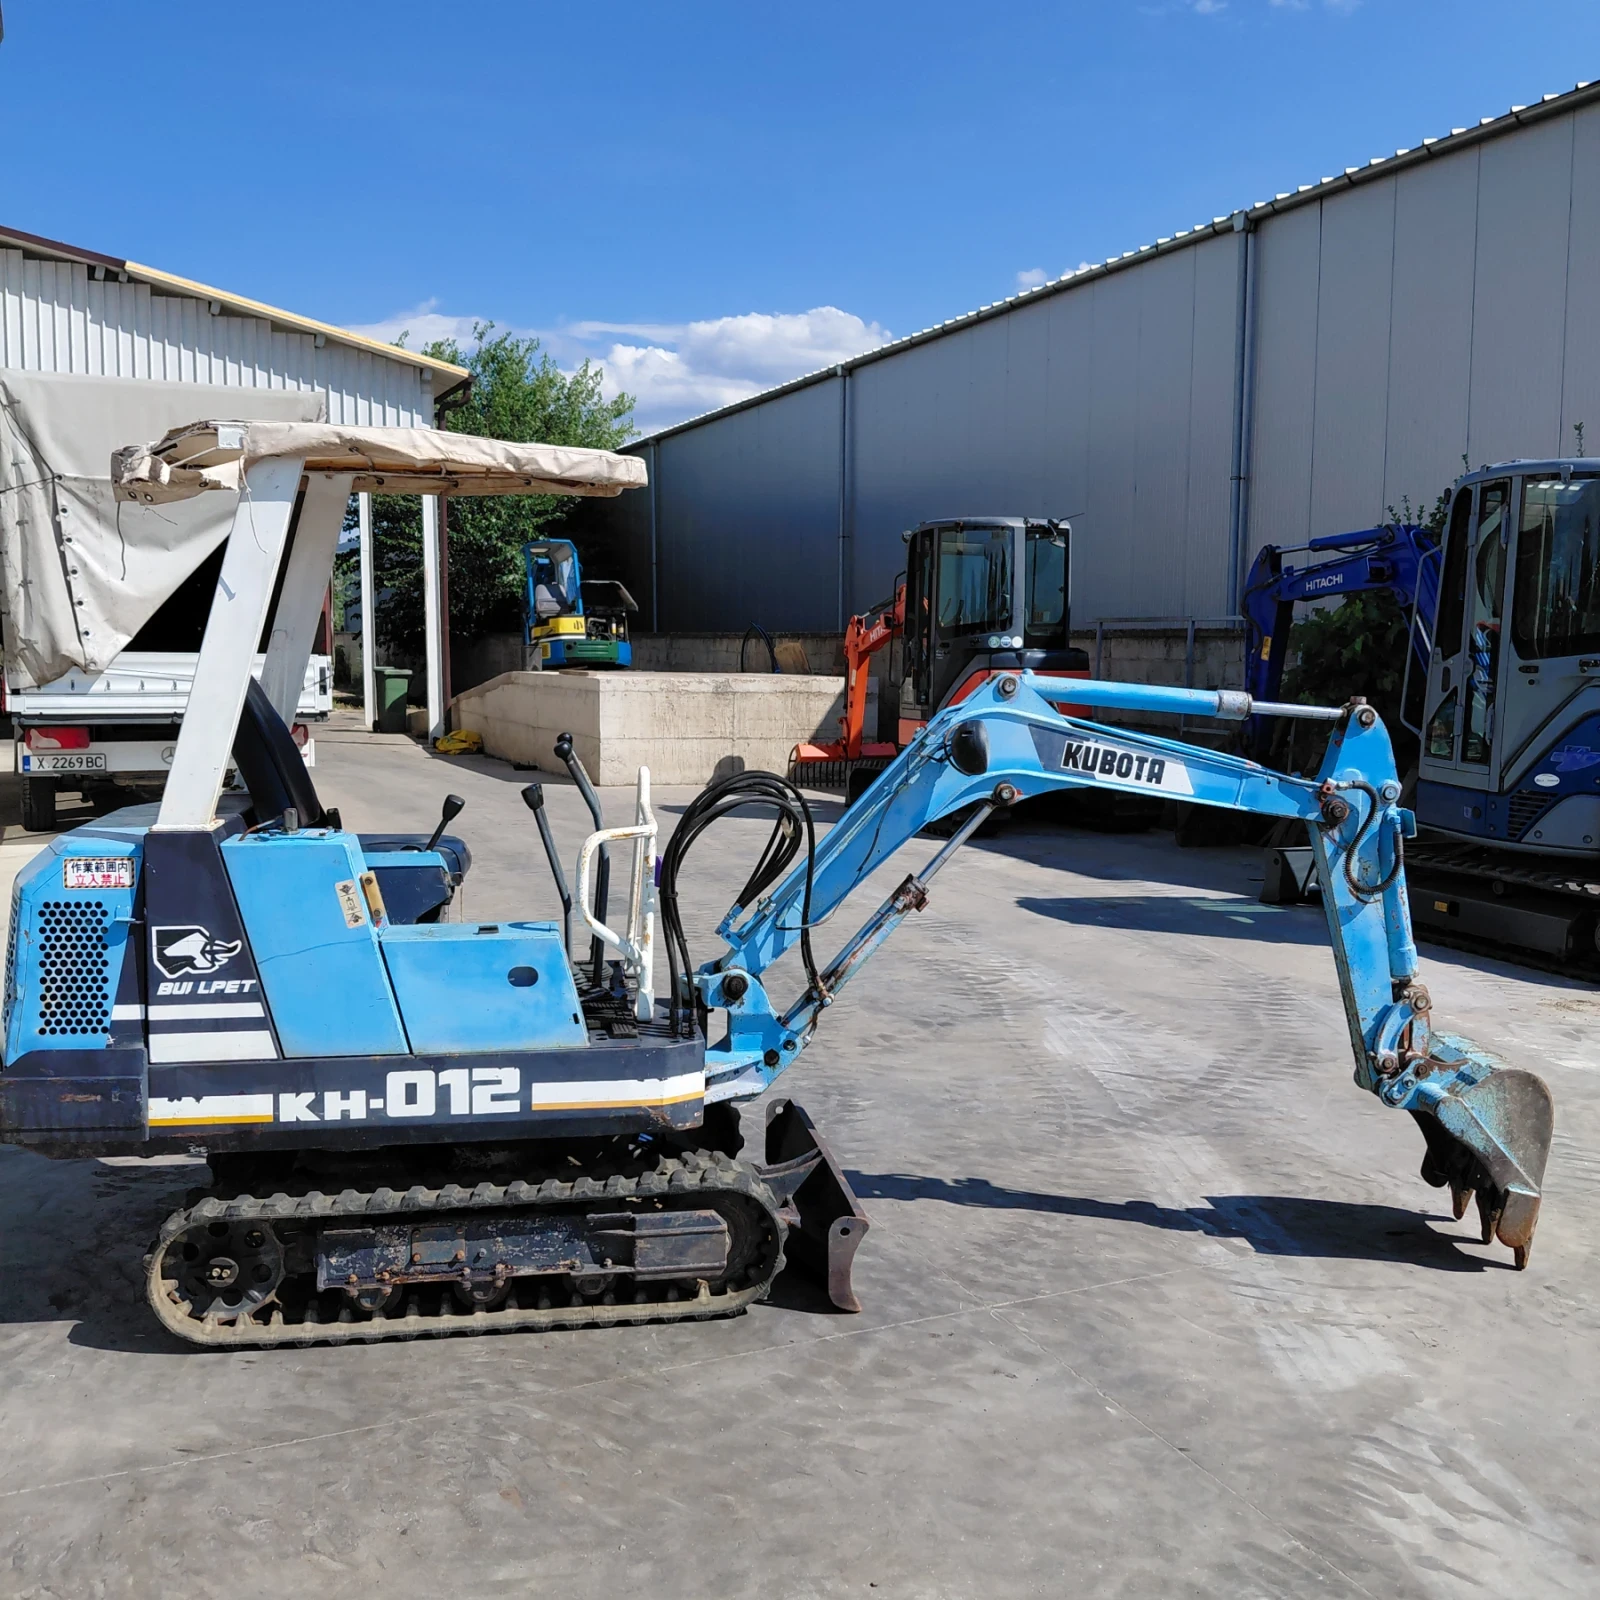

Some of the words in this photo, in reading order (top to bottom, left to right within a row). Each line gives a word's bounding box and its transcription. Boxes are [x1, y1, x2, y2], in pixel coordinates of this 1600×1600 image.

[1305, 573, 1343, 591] HITACHI
[52, 757, 84, 769] 2269
[86, 756, 103, 768] BC
[1062, 742, 1166, 785] KUBOTA
[71, 861, 128, 874] 作業範囲内
[74, 874, 126, 886] 立入禁止
[279, 1067, 521, 1123] KH-012
